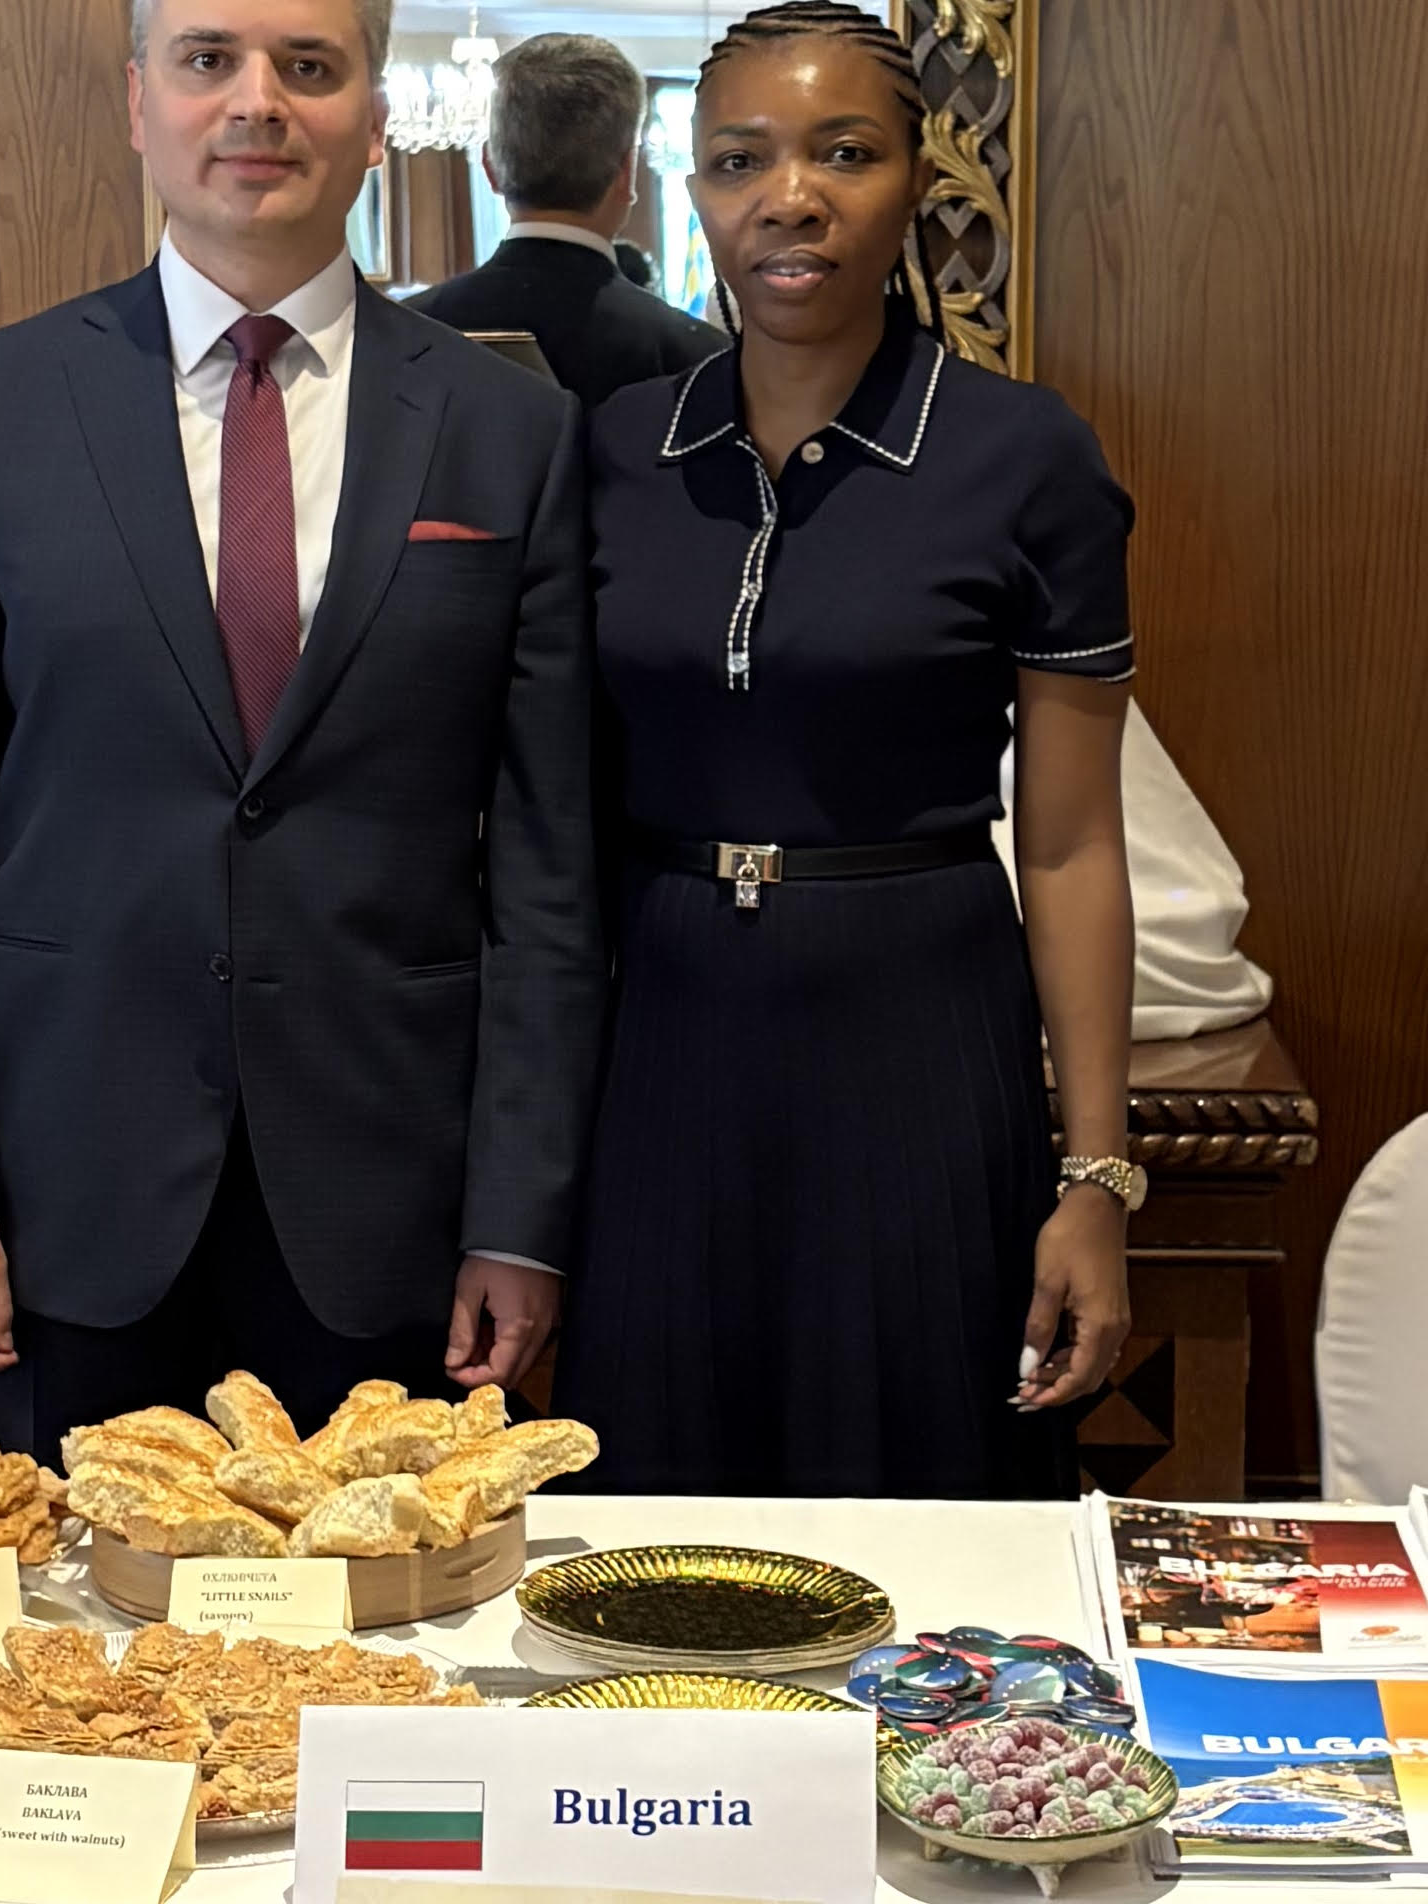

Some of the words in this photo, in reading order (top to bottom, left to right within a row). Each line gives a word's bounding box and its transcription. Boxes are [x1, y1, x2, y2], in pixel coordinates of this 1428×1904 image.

[26, 1783, 89, 1798] БАКЛАВА
[22, 1806, 82, 1821] BAKLAVA
[552, 1787, 754, 1837] Bulgaria
[40, 1830, 68, 1843] with
[71, 1833, 126, 1849] walnuts)
